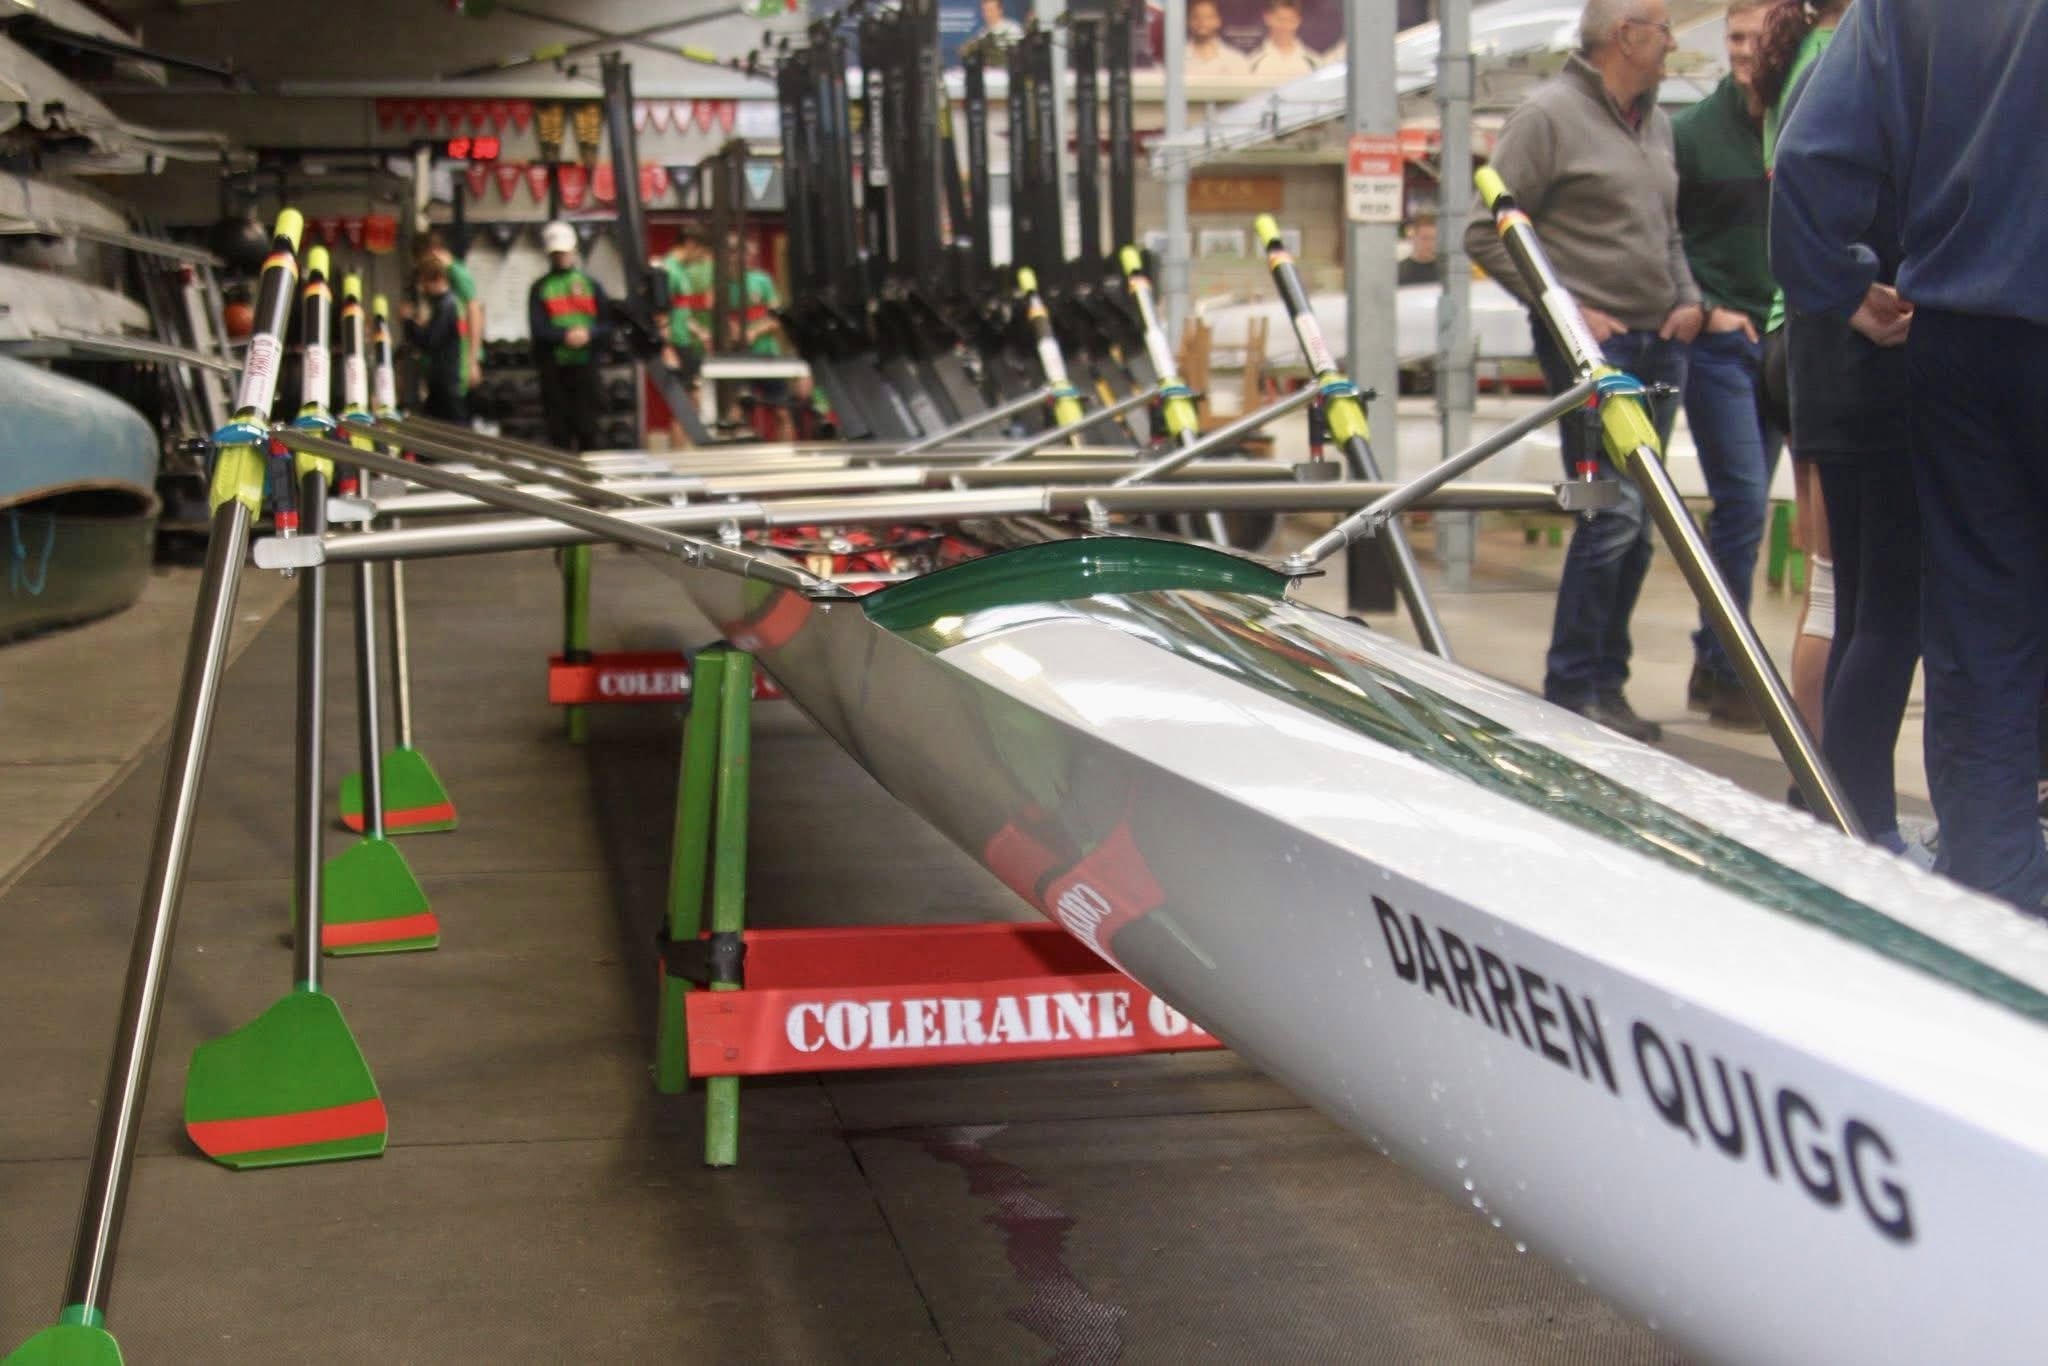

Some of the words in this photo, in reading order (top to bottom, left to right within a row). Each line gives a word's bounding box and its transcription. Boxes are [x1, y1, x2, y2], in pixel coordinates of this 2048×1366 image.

[786, 991, 1134, 1052] COLERAINE
[1148, 994, 1206, 1037] G
[1371, 894, 1620, 1097] DARREN
[1631, 1020, 1917, 1245] QUIGG
